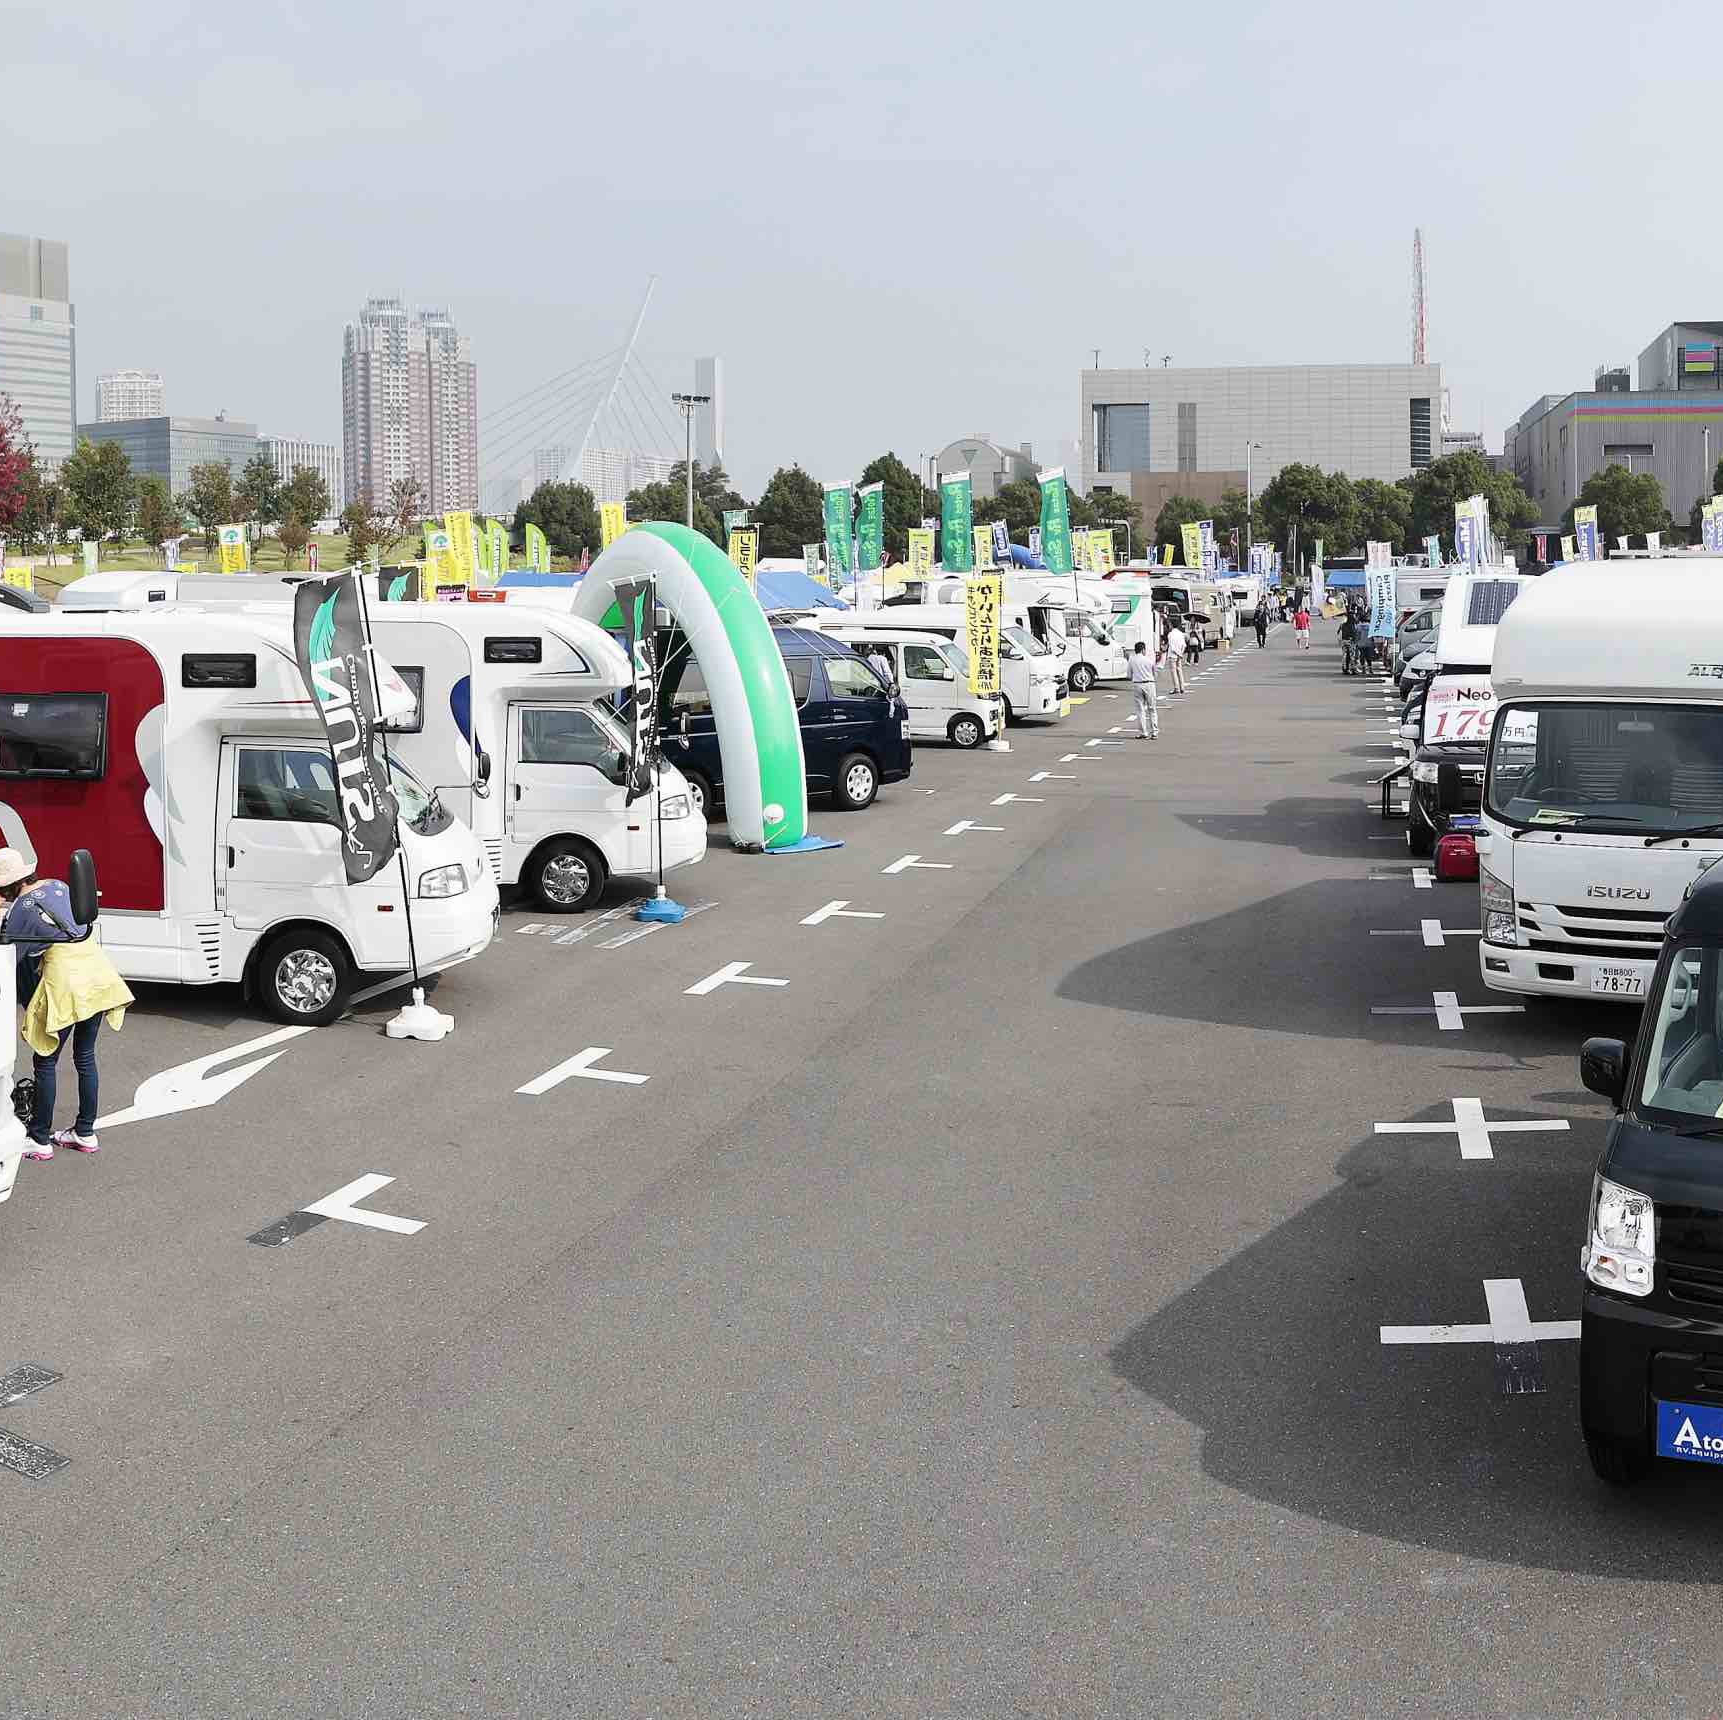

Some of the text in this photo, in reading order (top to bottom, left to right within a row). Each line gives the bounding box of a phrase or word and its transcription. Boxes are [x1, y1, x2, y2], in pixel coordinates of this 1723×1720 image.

[1456, 687, 1492, 702] Neo
[1587, 885, 1651, 900] ISUZU
[1602, 976, 1641, 993] 78-77
